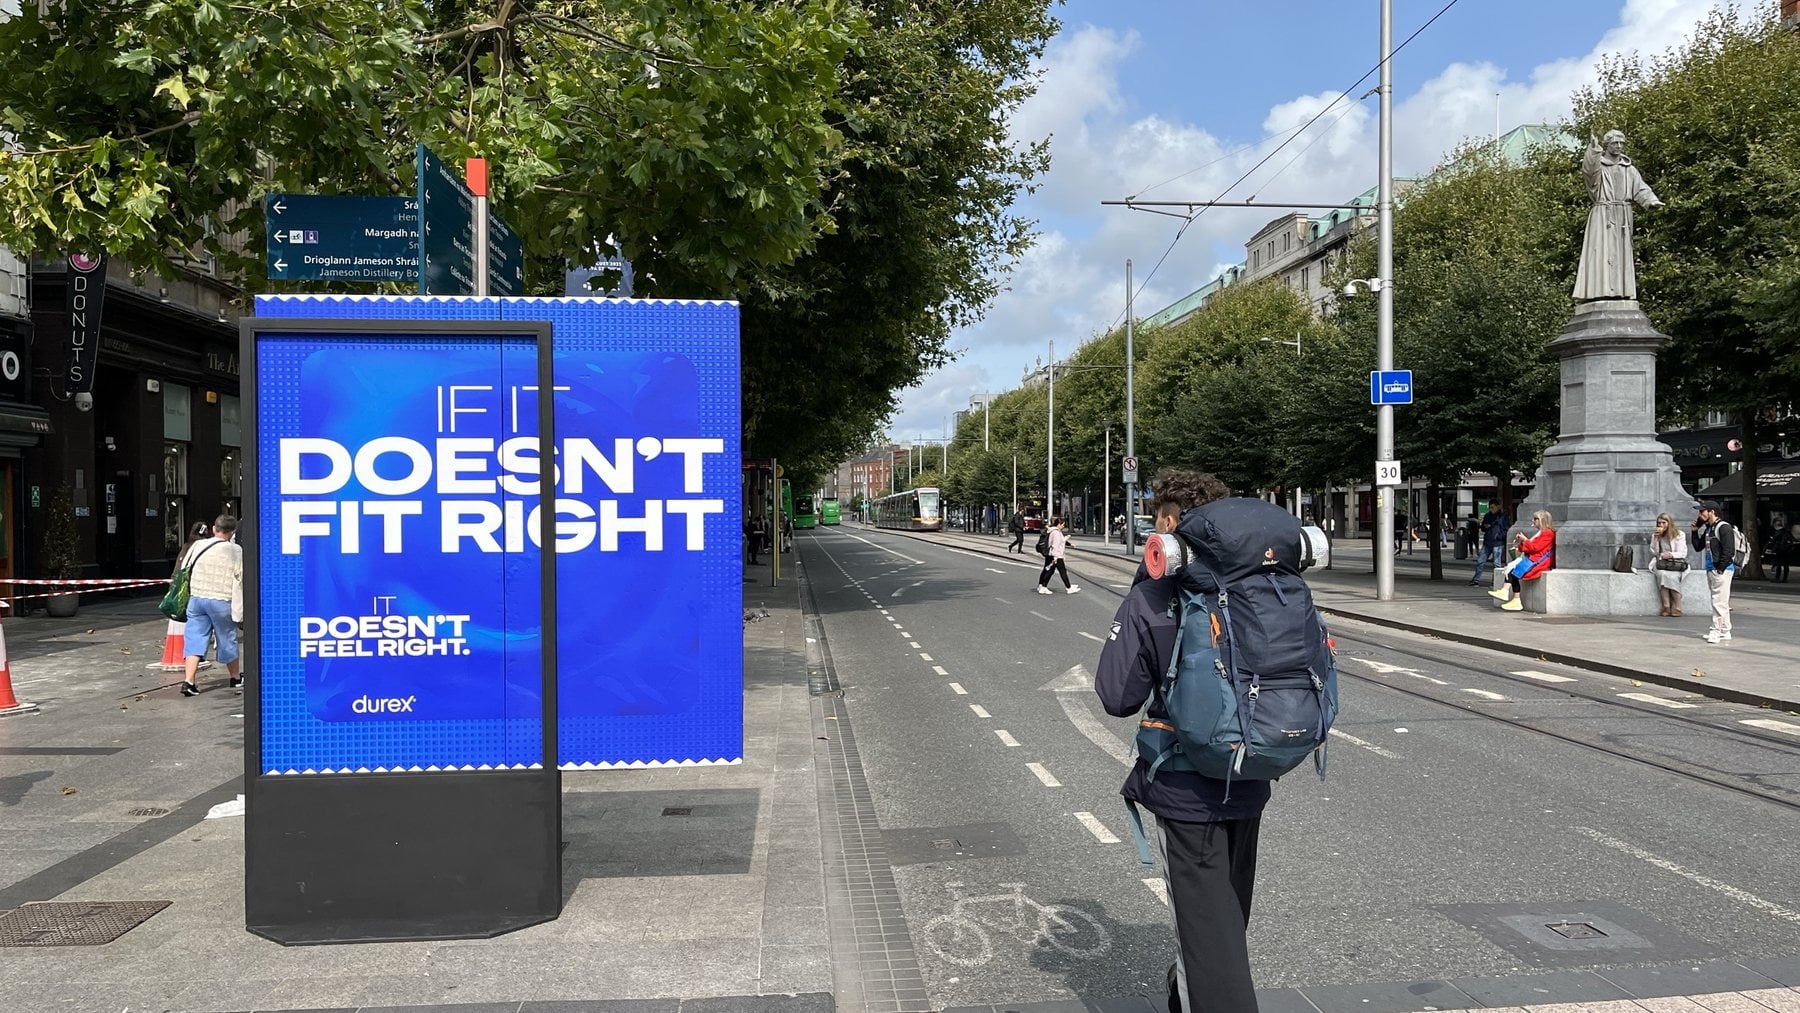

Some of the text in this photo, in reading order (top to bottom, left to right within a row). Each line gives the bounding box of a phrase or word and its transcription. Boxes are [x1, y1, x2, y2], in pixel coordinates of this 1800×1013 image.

[365, 228, 408, 238] Margadh
[304, 255, 351, 266] Drioglann
[353, 256, 393, 266] Jameson
[319, 268, 361, 277] Jameson
[363, 268, 404, 280] Distillery
[70, 276, 88, 382] DONUTS
[437, 385, 493, 433] IF
[279, 436, 724, 496] DOESN'T
[1380, 467, 1397, 479] 30
[281, 498, 724, 555] FIT RIGHT
[373, 596, 397, 616] IT
[299, 614, 471, 639] DOESN'T
[300, 637, 471, 658] FEEL RIGHT.
[351, 694, 416, 714] durex
